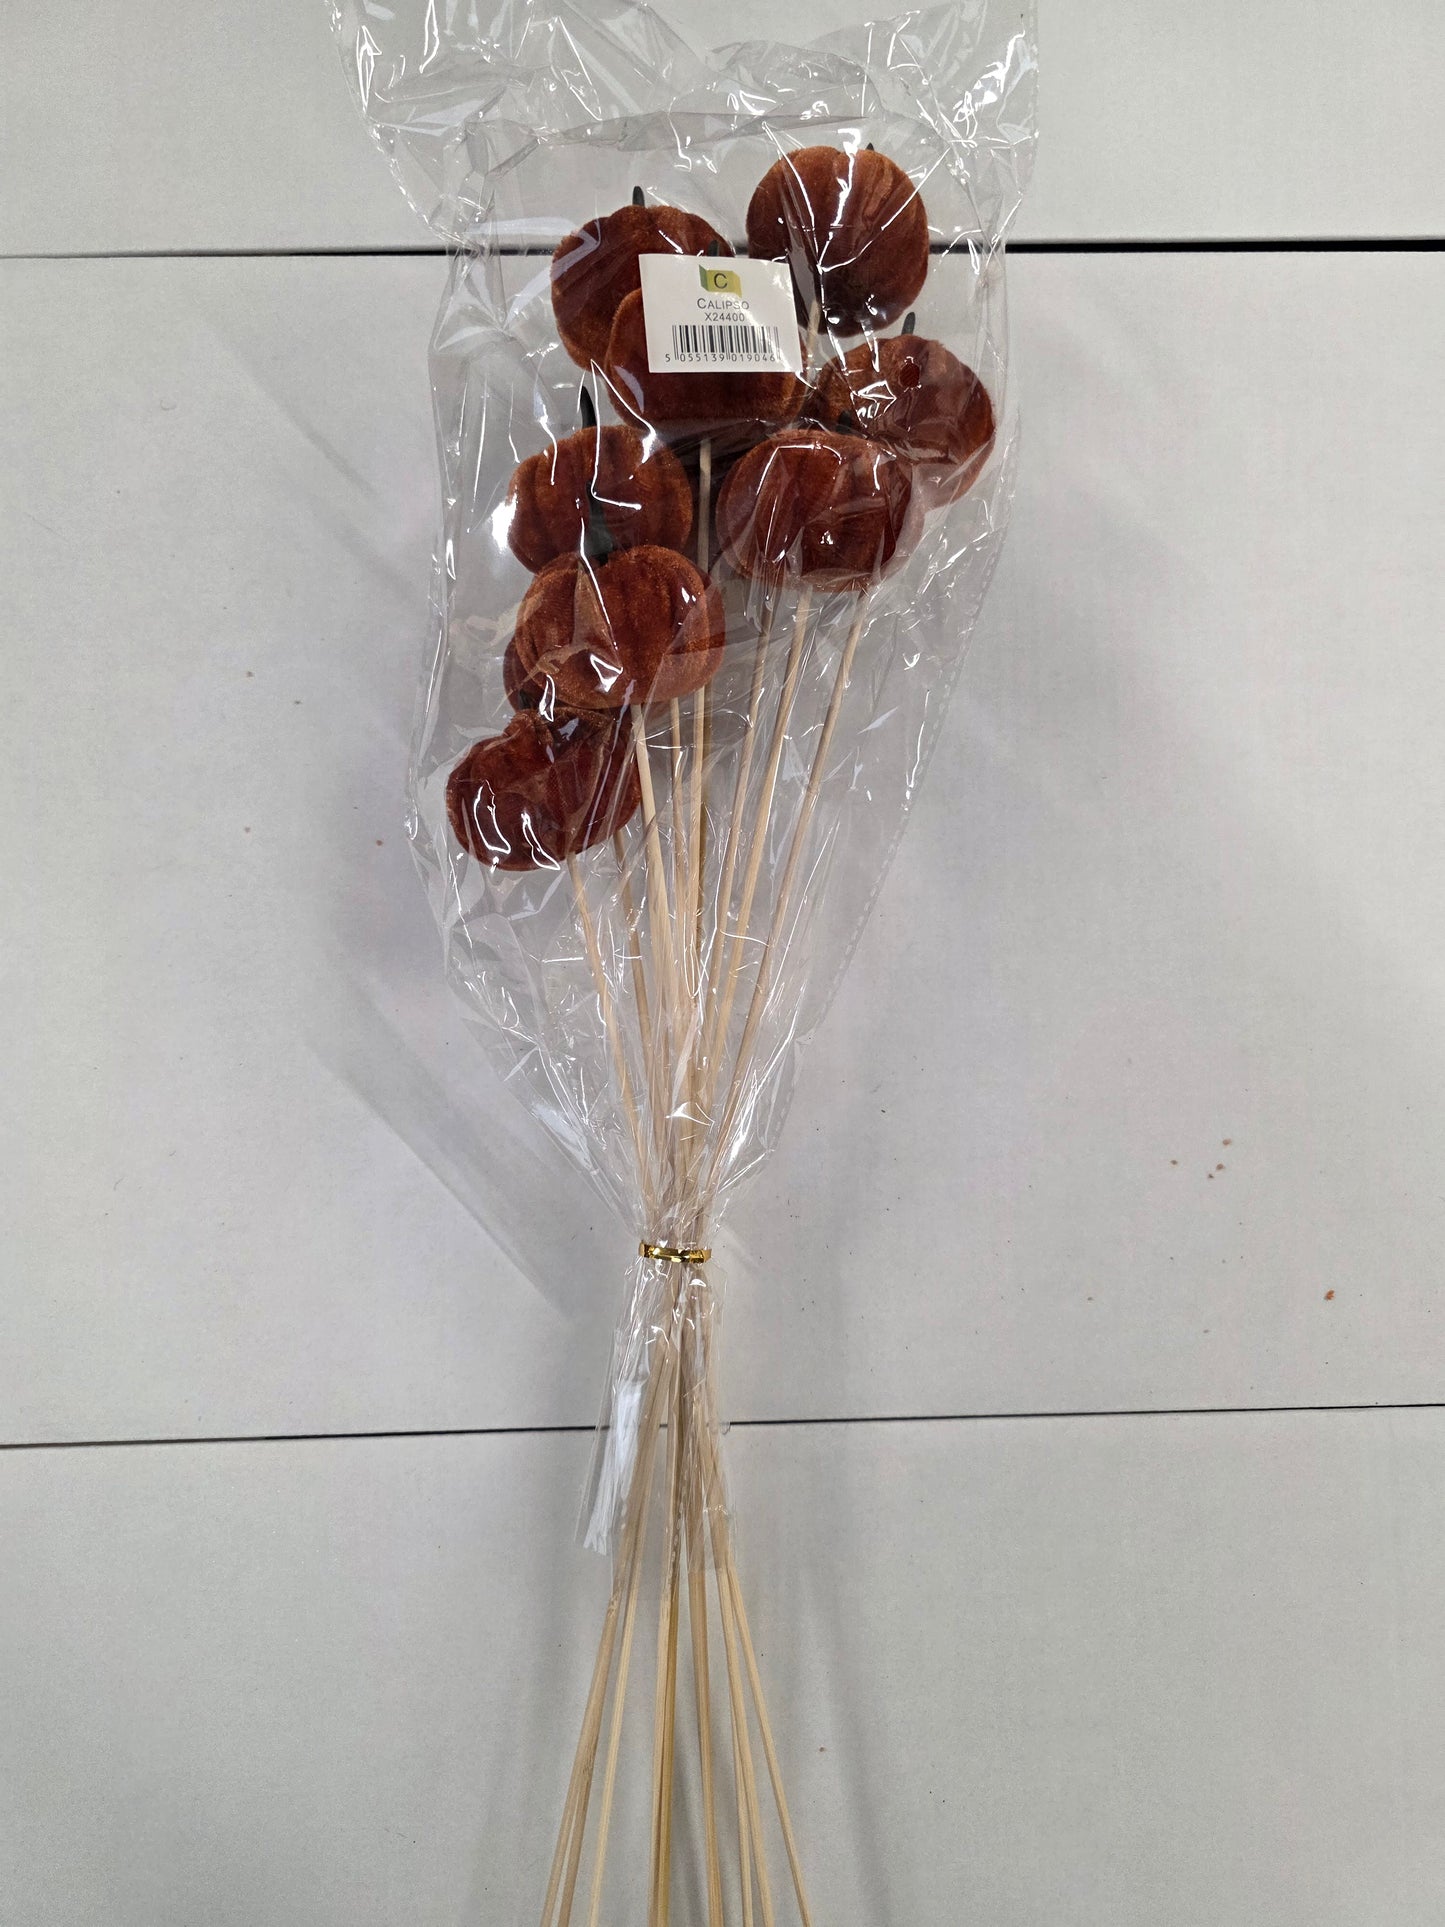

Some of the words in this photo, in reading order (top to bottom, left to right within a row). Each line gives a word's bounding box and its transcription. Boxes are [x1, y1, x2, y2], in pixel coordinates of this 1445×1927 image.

[713, 272, 728, 289] C
[697, 298, 750, 310] CALIPSO
[704, 312, 745, 322] X24400
